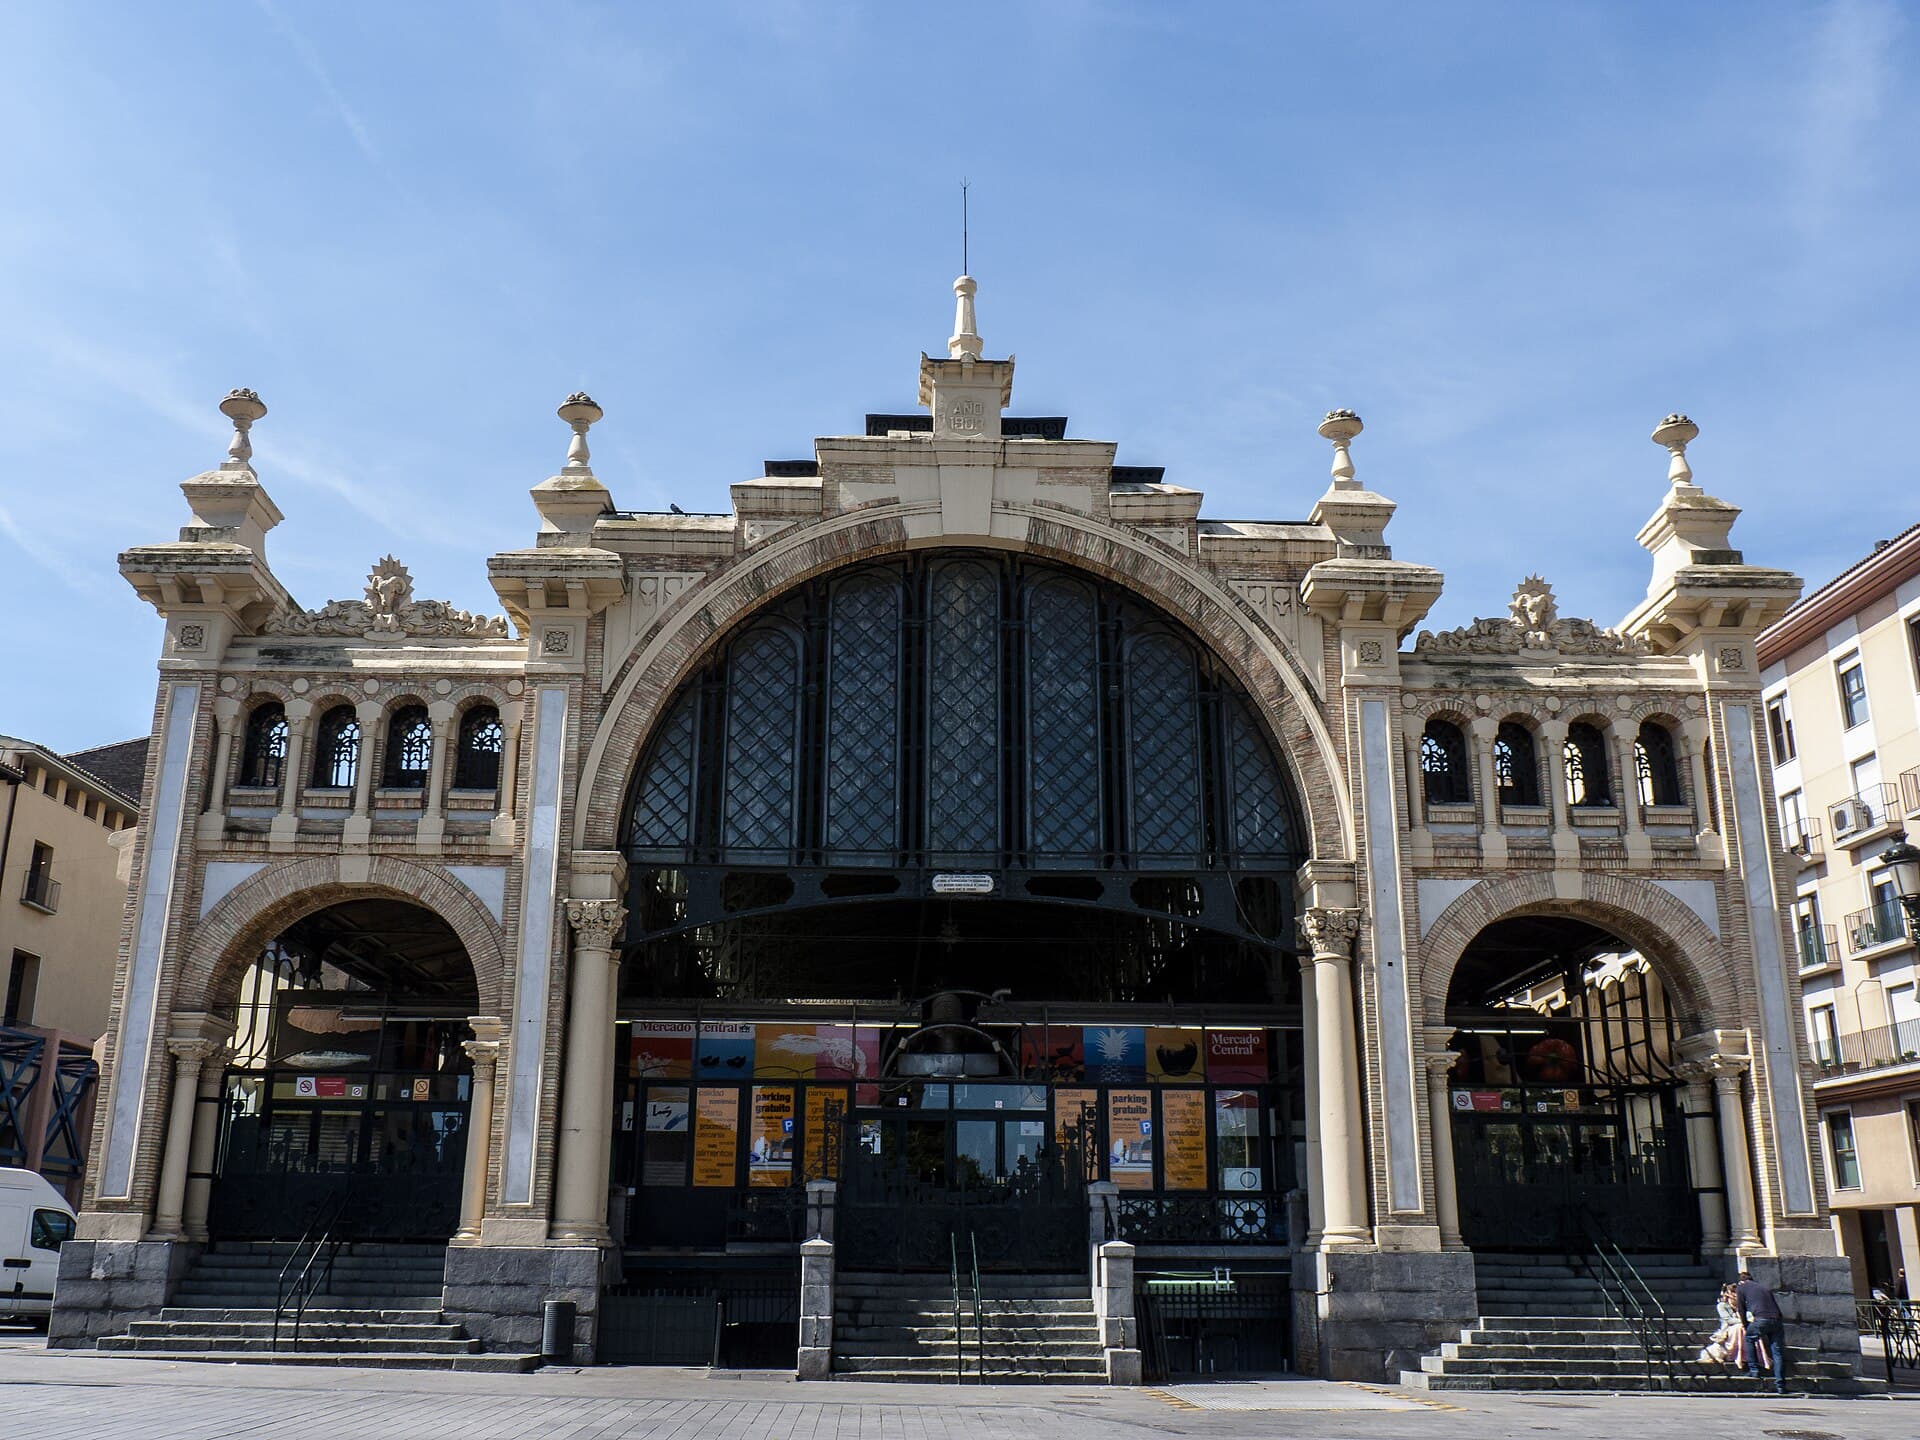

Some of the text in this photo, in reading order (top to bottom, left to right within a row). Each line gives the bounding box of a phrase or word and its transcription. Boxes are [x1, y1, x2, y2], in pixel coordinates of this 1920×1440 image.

[641, 1023, 691, 1033] Mercado
[1211, 1033, 1260, 1045] Mercado
[1212, 1044, 1254, 1055] Central
[756, 1092, 791, 1103] parking
[1112, 1094, 1147, 1104] parking
[756, 1103, 791, 1114] gratuito
[1112, 1105, 1147, 1116] gratuito
[785, 1120, 793, 1132] P
[1143, 1122, 1151, 1133] P
